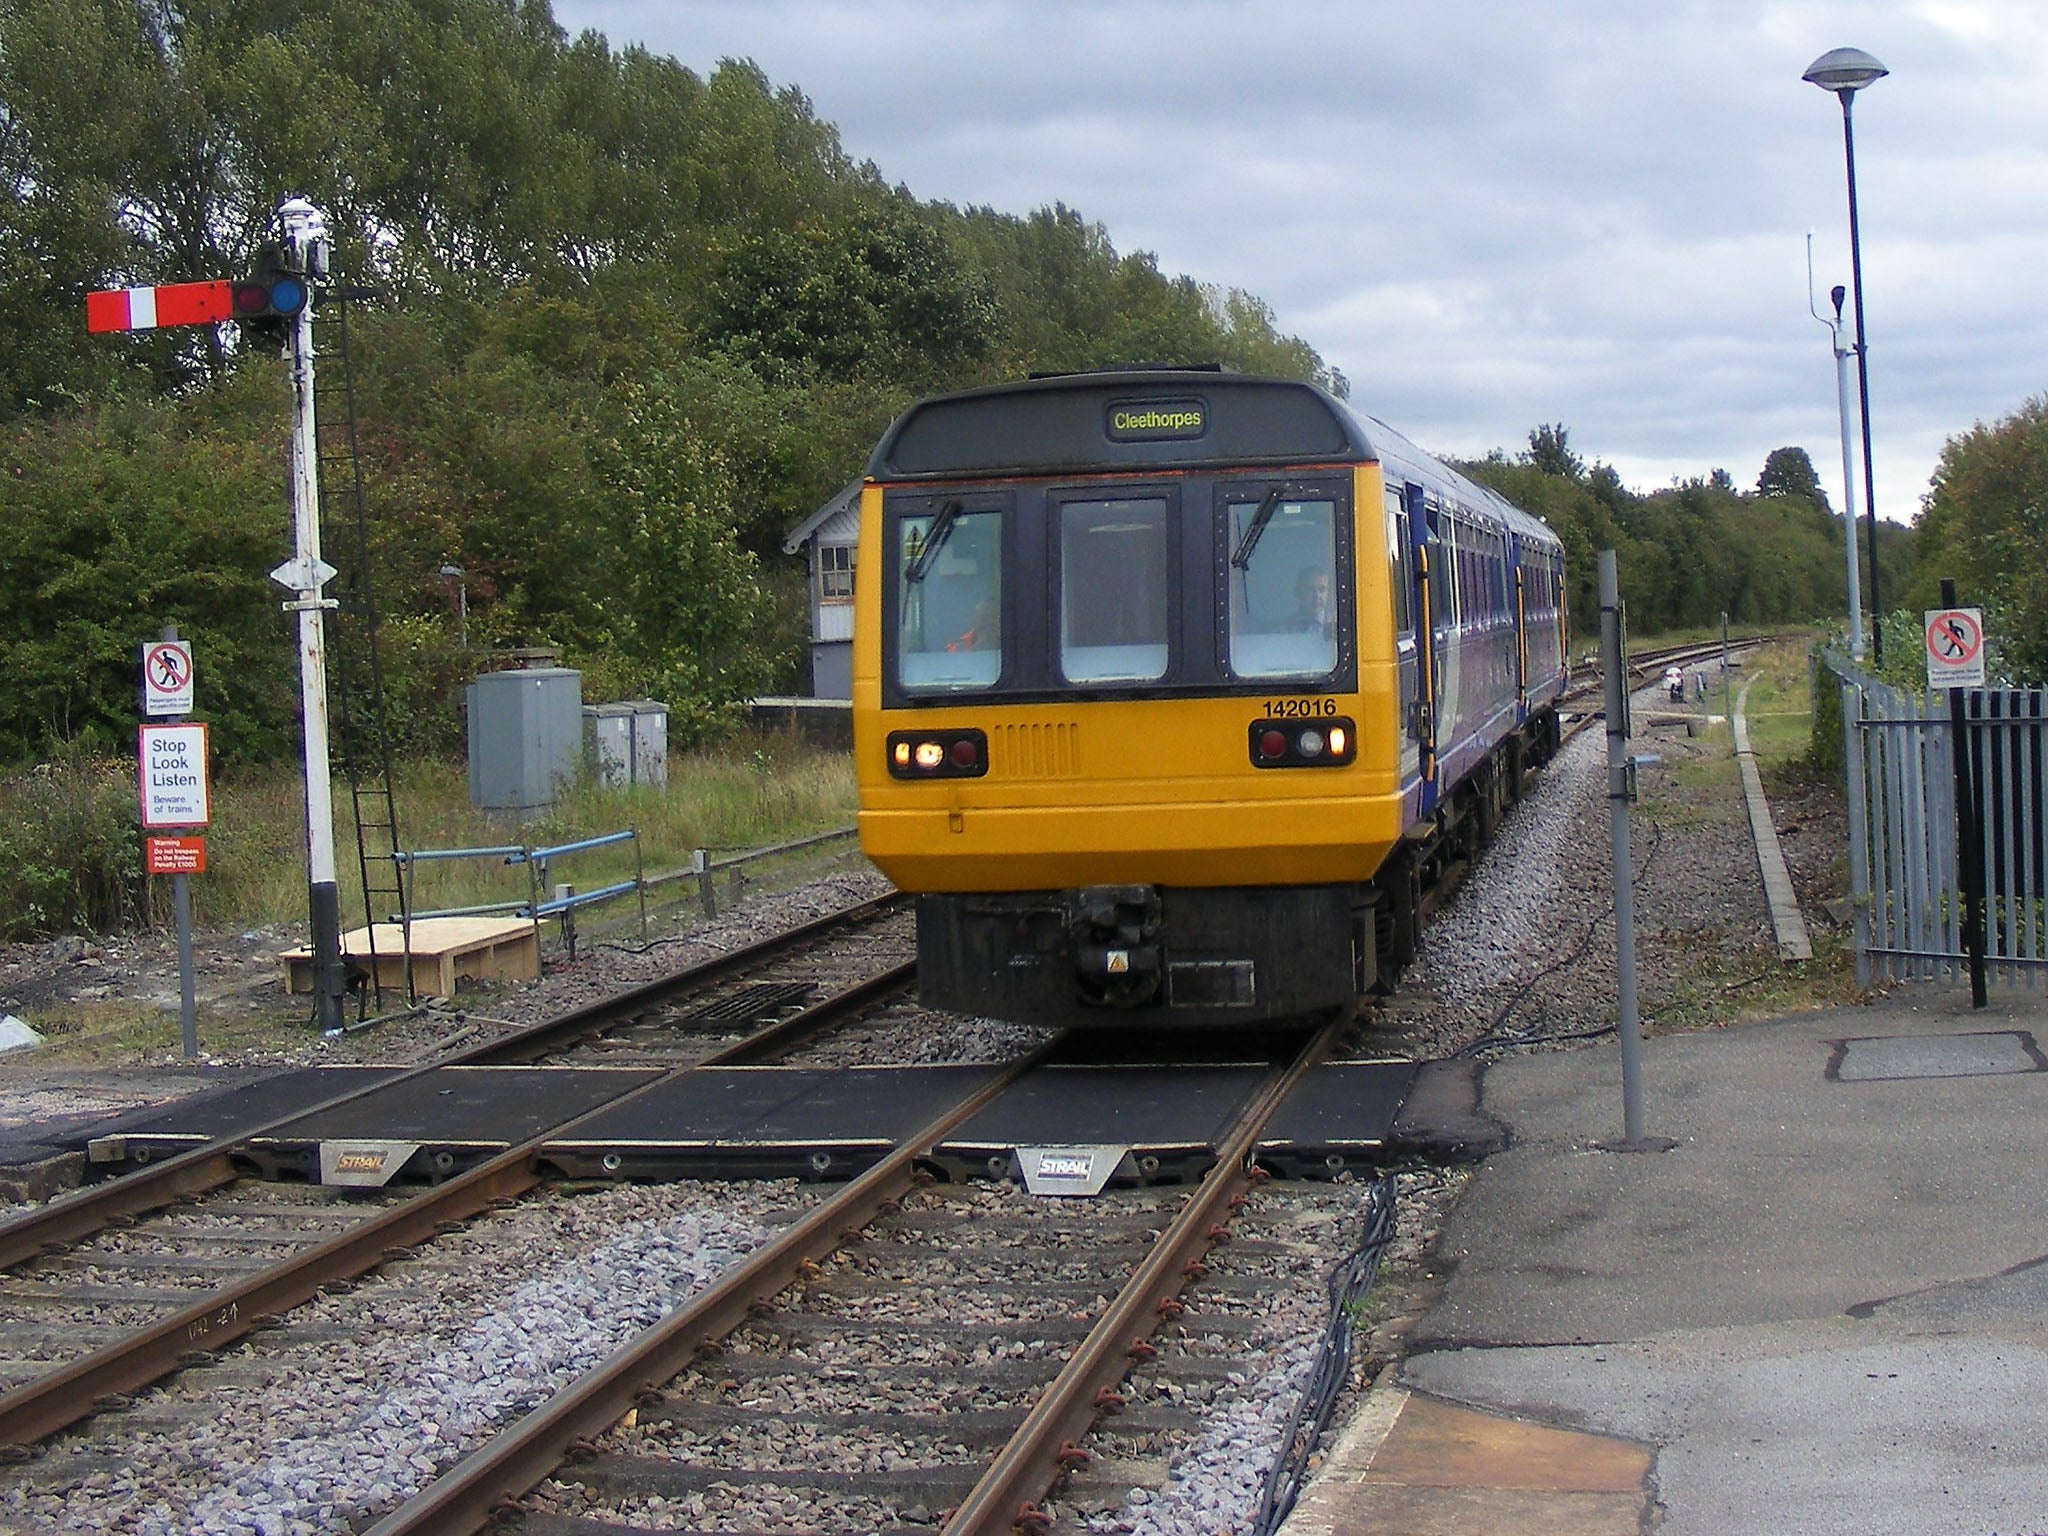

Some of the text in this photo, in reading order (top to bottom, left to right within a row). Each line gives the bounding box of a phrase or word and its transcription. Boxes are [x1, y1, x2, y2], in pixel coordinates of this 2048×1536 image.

[1114, 411, 1201, 430] Cleethorpes
[1263, 699, 1336, 717] 142016
[152, 739, 187, 754] Stop
[152, 756, 189, 770] Look
[153, 773, 197, 787] Listen
[153, 795, 186, 804] Beware
[154, 805, 193, 814] of trains
[154, 861, 177, 869] Penalty
[338, 1156, 384, 1168] STRAIL
[1040, 1160, 1089, 1174] STRAIL
